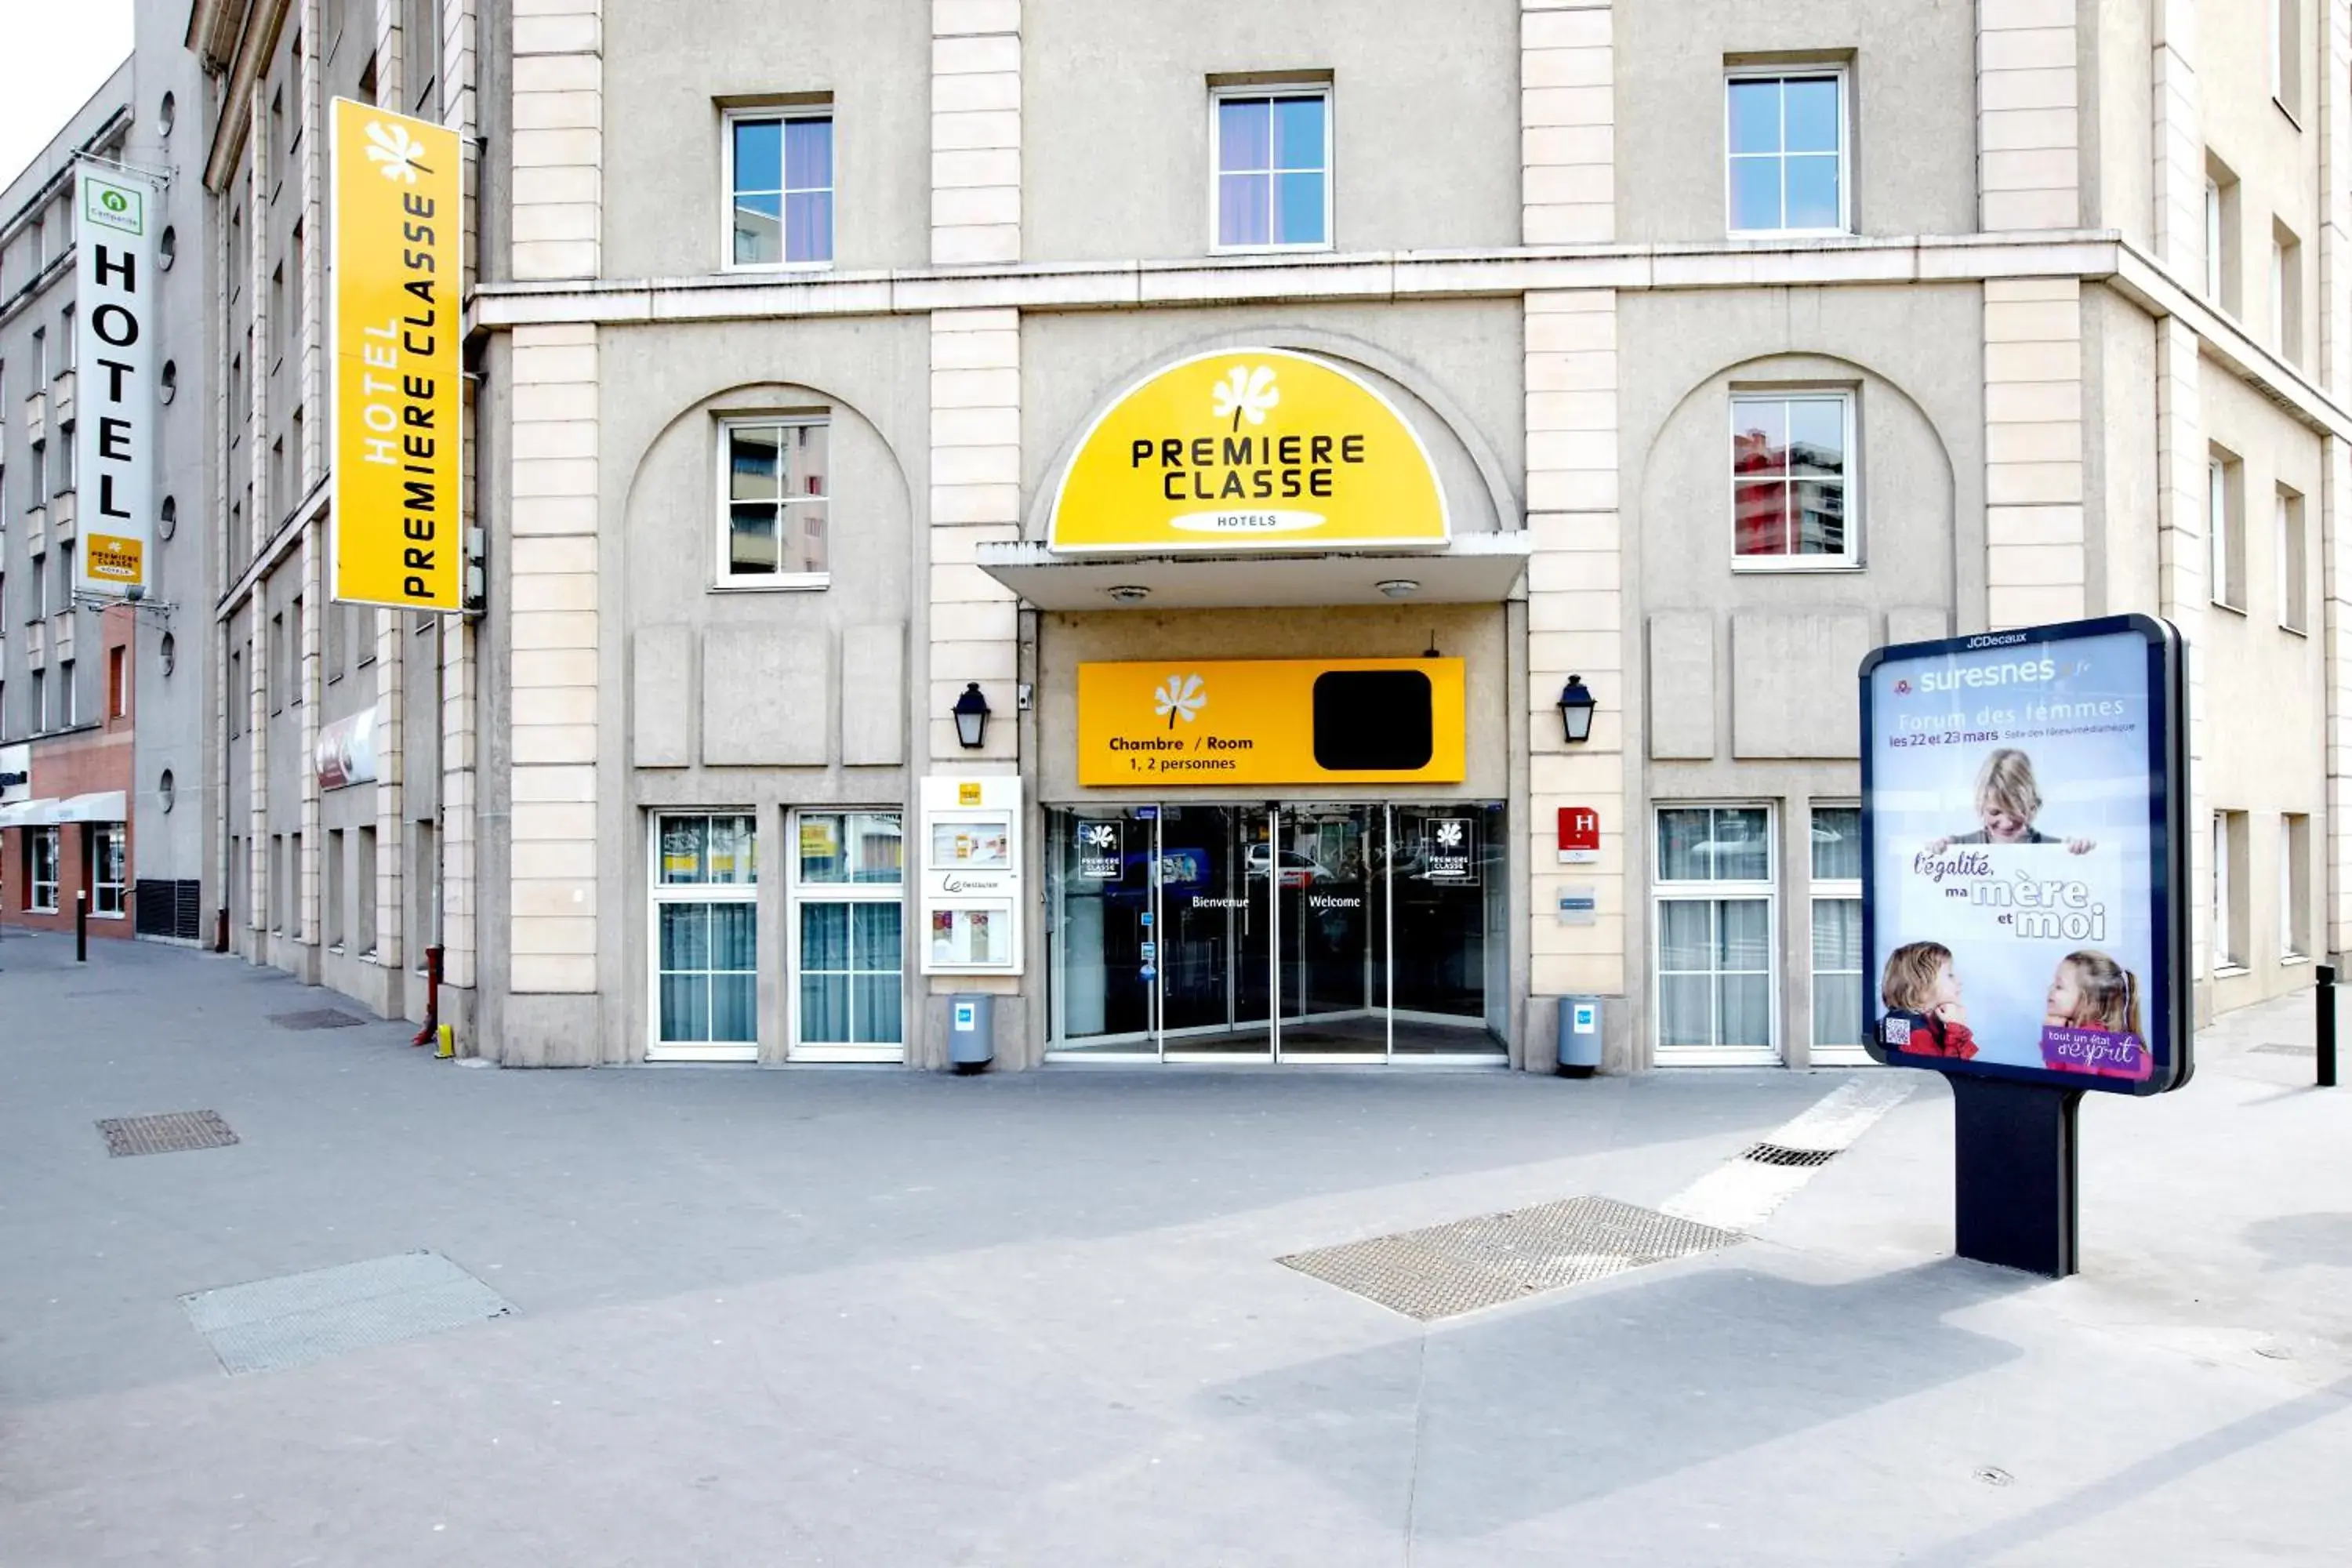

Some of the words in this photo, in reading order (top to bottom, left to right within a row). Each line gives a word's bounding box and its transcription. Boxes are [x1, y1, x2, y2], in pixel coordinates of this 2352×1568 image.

[403, 192, 435, 357] CLASSE
[92, 244, 139, 519] HOTEL
[364, 318, 397, 465] HOTEL
[1132, 434, 1365, 468] PREMIERE
[403, 375, 435, 599] PREMIERE
[1164, 468, 1332, 500] CLASSE
[1217, 514, 1277, 528] HOTELS
[1966, 632, 2027, 649] JCDecaux
[1899, 713, 1965, 731] Forum
[1976, 706, 2016, 727] des
[2025, 699, 2124, 721] femmes
[1109, 737, 1185, 751] Chambre
[1207, 736, 1254, 750] Room
[1889, 735, 1907, 747] les
[1909, 734, 1926, 746] 22
[1929, 734, 1940, 745] et
[1944, 731, 1961, 744] 23
[1963, 730, 1999, 743] mars
[1147, 758, 1156, 770] 2
[1160, 757, 1236, 773] personnes
[1576, 815, 1594, 831] H
[1192, 895, 1250, 908] Bienvenue
[1308, 895, 1361, 908] Welcome
[1945, 887, 1968, 898] ma
[1972, 869, 2089, 908] mère
[1998, 913, 2013, 924] et
[2015, 902, 2105, 941] moi
[2049, 1032, 2071, 1042] tout
[2074, 1034, 2087, 1043] un
[2058, 1036, 2140, 1066] d'esprit
